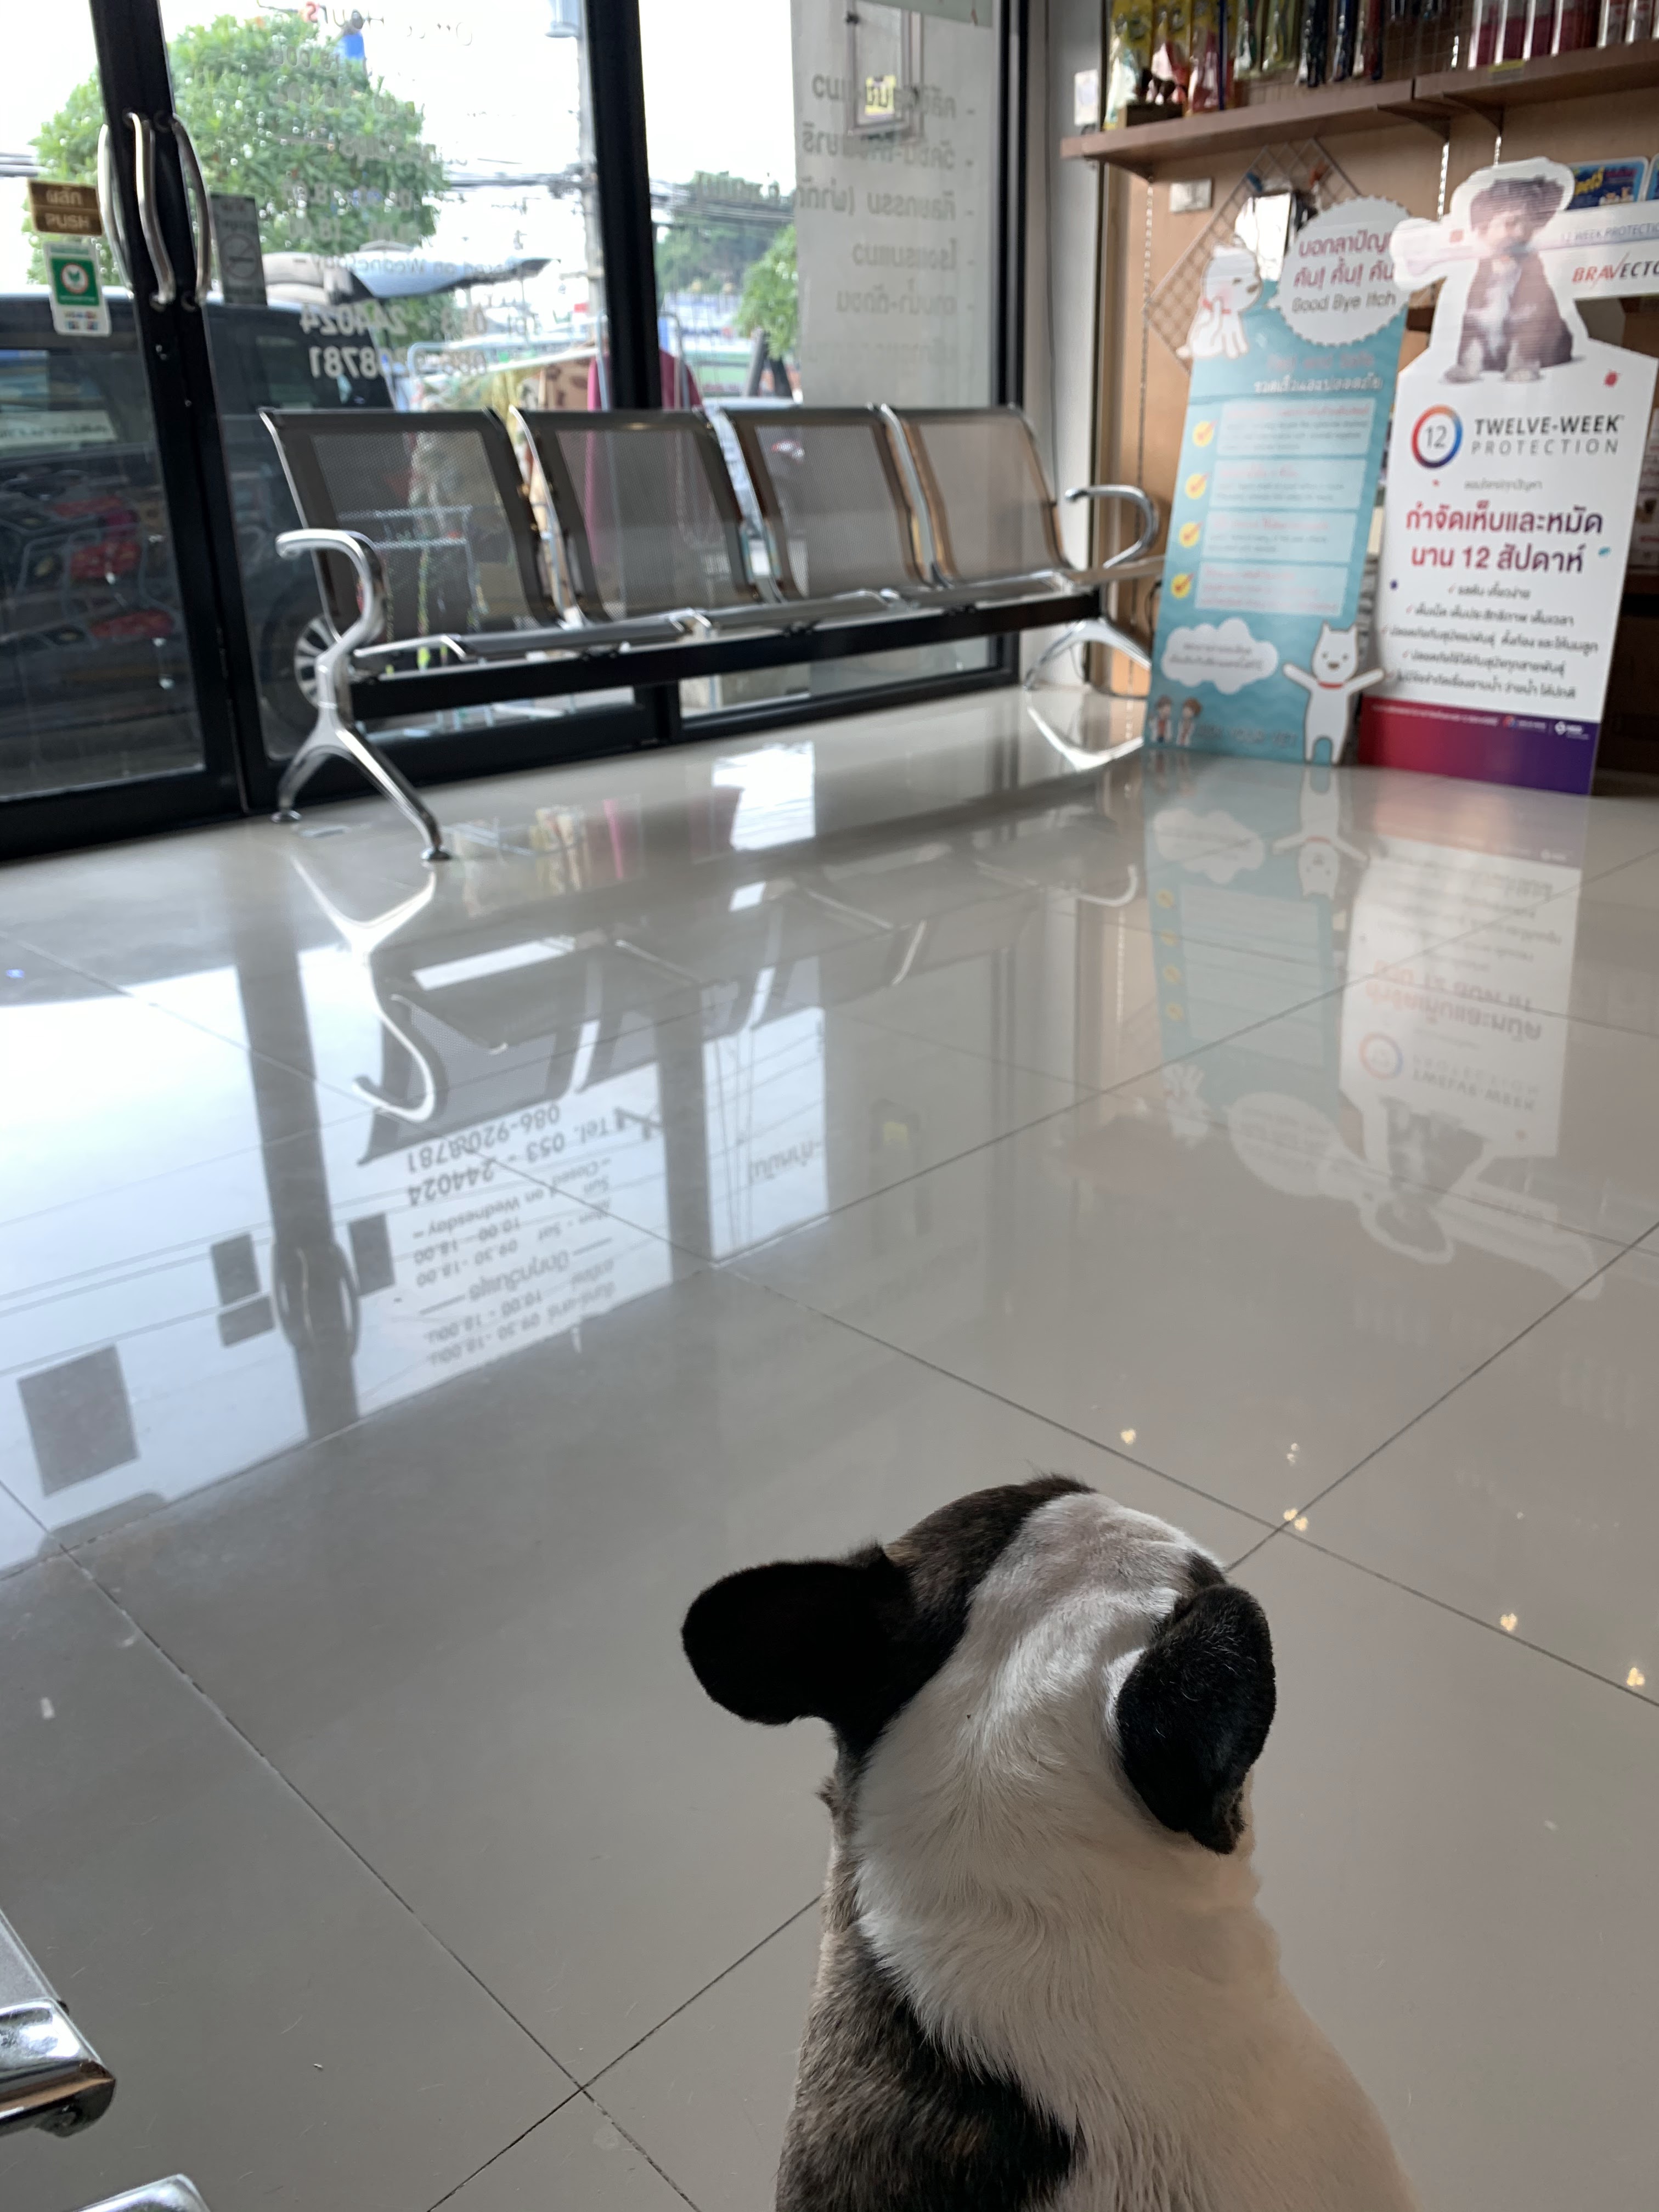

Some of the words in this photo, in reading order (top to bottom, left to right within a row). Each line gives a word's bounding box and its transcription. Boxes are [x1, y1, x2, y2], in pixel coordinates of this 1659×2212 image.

[44, 213, 90, 230] PUSH
[1331, 294, 1362, 312] Bye
[1425, 425, 1448, 449] 12
[1475, 414, 1618, 436] TWELVE-WEEK
[1471, 438, 1618, 456] PROTECTION
[1406, 499, 1604, 534] กำจัดเห็บและหมัด
[1410, 545, 1455, 567] นาน
[1462, 546, 1491, 567] 12
[1497, 542, 1587, 573] สัปดาห์
[407, 1103, 562, 1172] 086-9208781
[526, 1130, 565, 1160] 053
[407, 1155, 494, 1206] 244024
